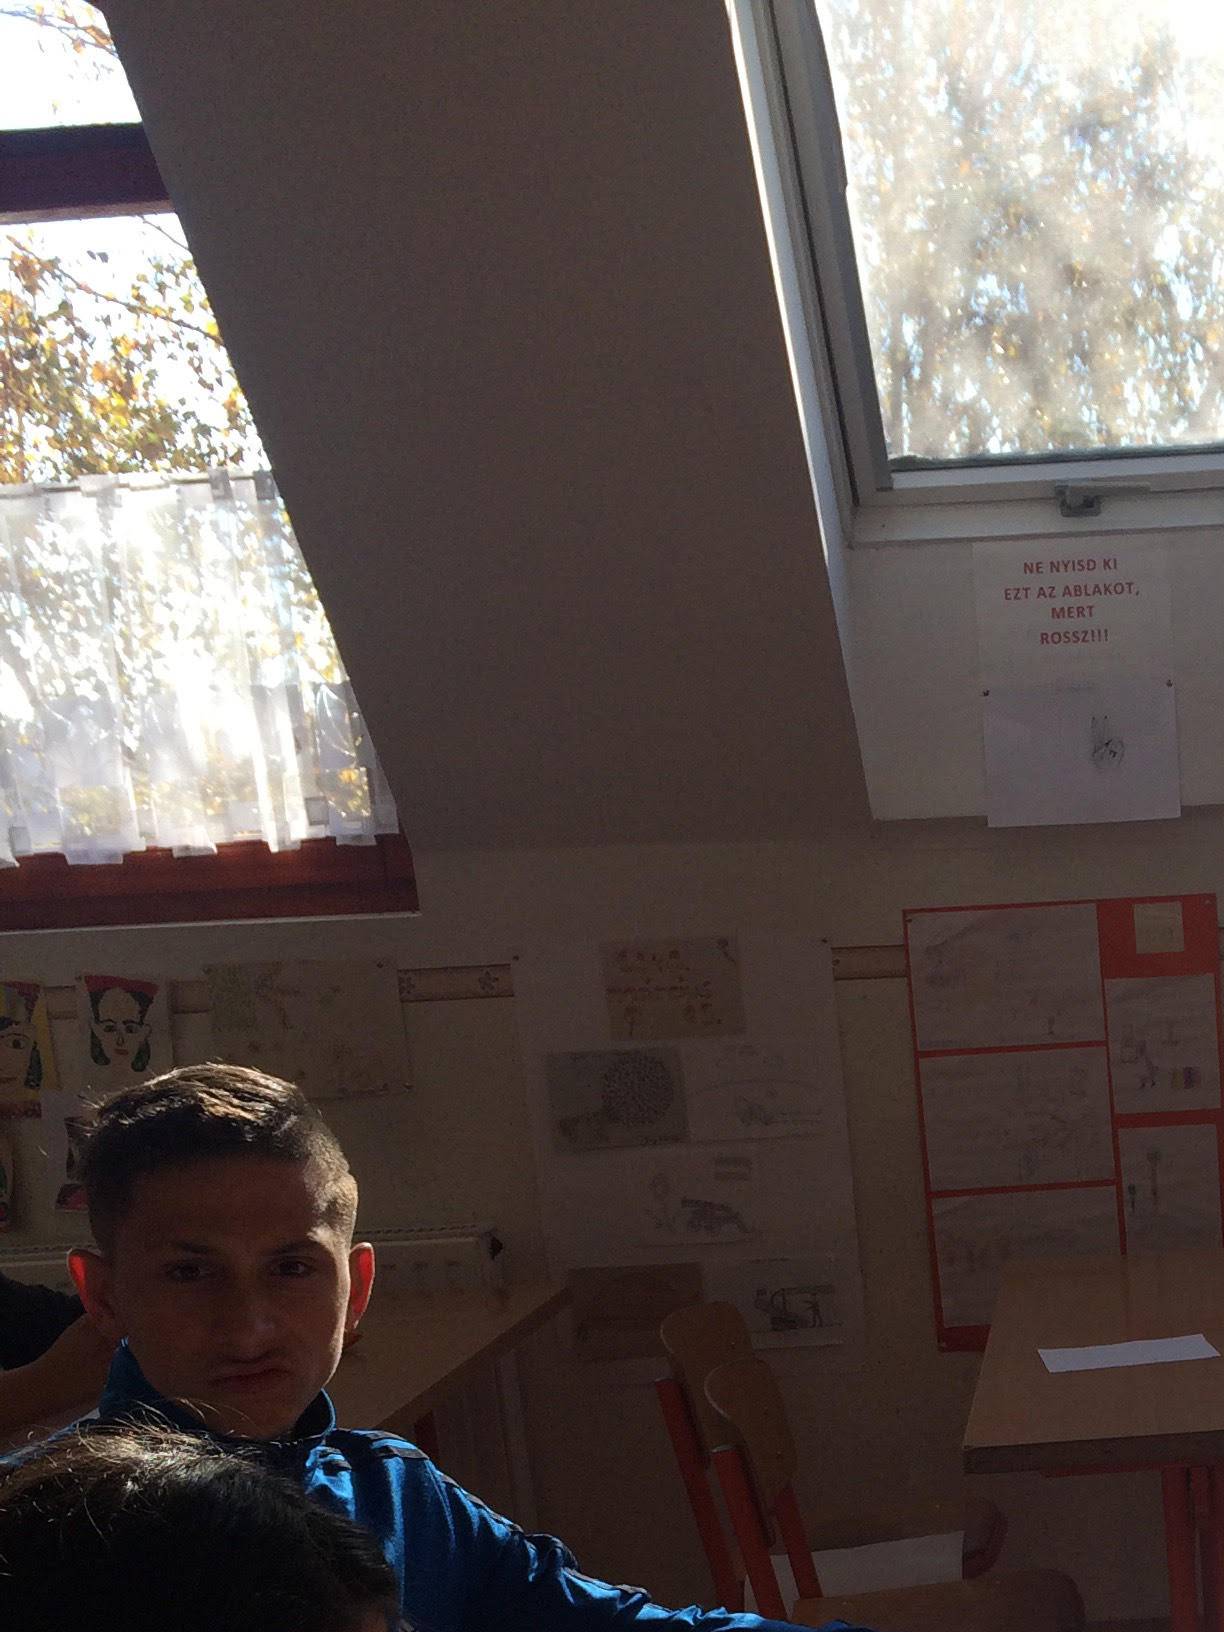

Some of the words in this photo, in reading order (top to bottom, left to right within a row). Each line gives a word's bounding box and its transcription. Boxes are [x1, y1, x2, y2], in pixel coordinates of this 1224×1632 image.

[1023, 562, 1043, 574] NE
[1050, 559, 1096, 573] NYISD
[1103, 558, 1117, 570] KI
[1004, 587, 1030, 600] EZT
[1036, 586, 1056, 599] AZ
[1062, 583, 1139, 597] ABLAKOT,
[1051, 605, 1094, 619] MERT
[1040, 629, 1108, 645] ROSSZ!!!
